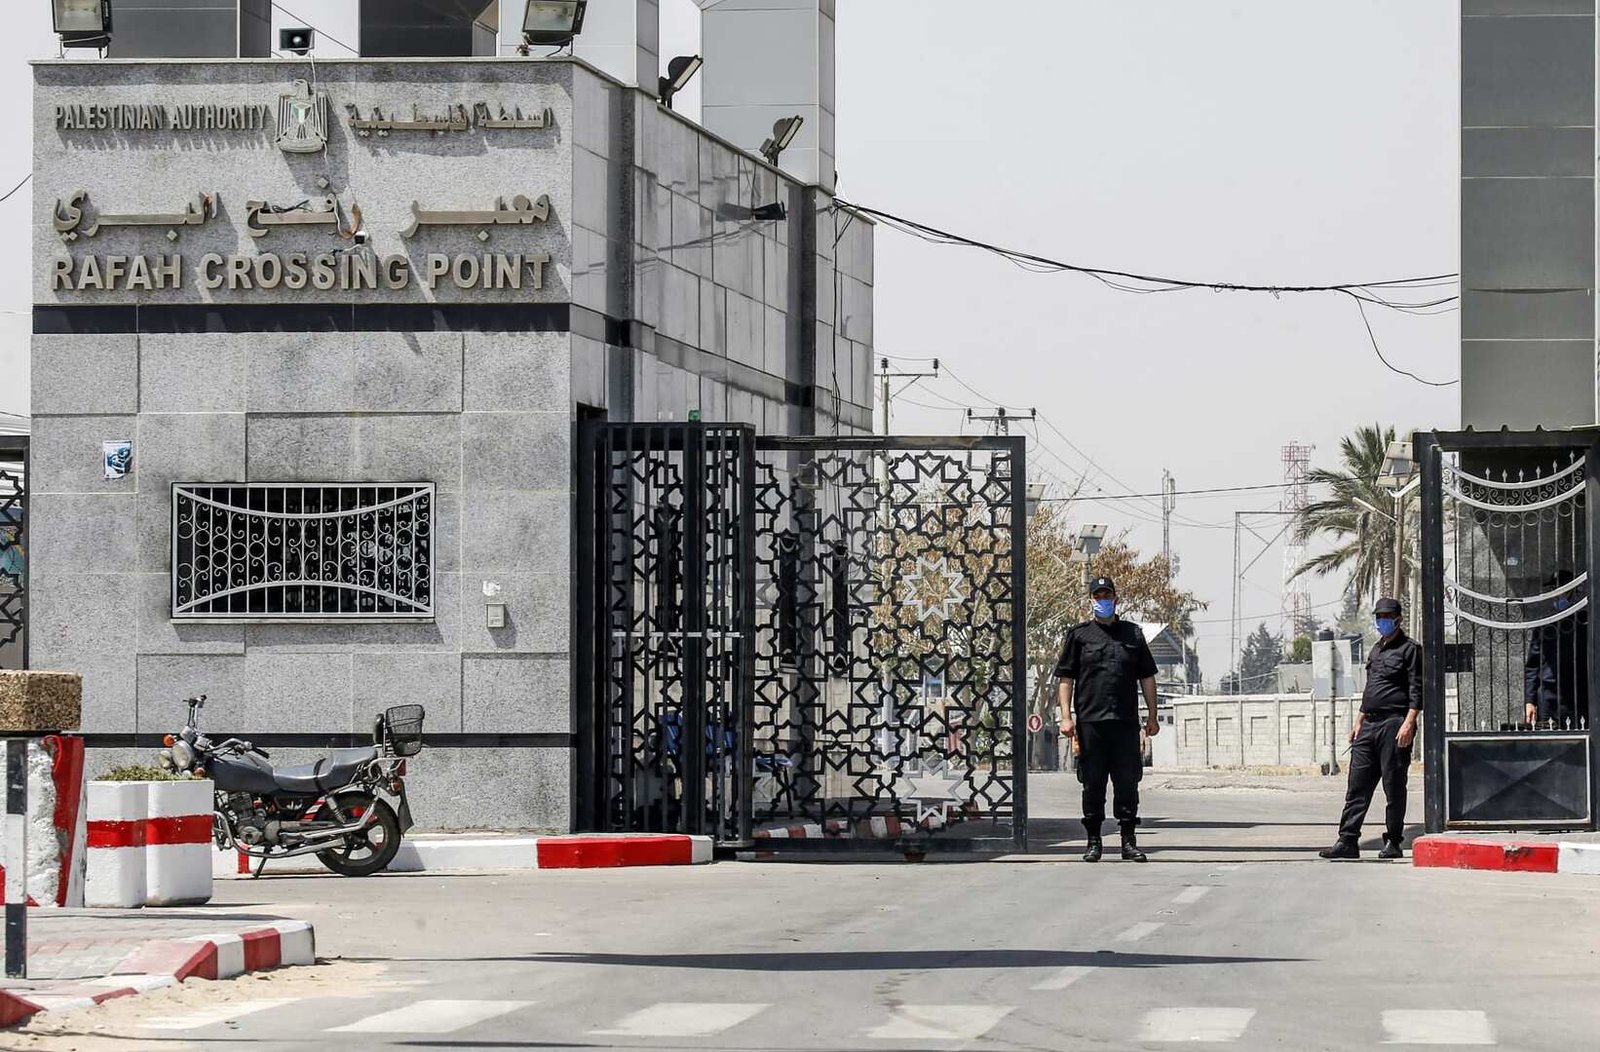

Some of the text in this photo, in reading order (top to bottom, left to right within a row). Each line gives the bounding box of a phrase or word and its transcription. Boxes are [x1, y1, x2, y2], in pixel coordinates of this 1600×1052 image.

[55, 104, 268, 130] PALESTINIAN AUTHORITY
[345, 101, 553, 137] السلطة الفلسطينية
[53, 176, 549, 243] معبر رفح البري
[53, 253, 550, 290] RAFAH CROSSING POINT
